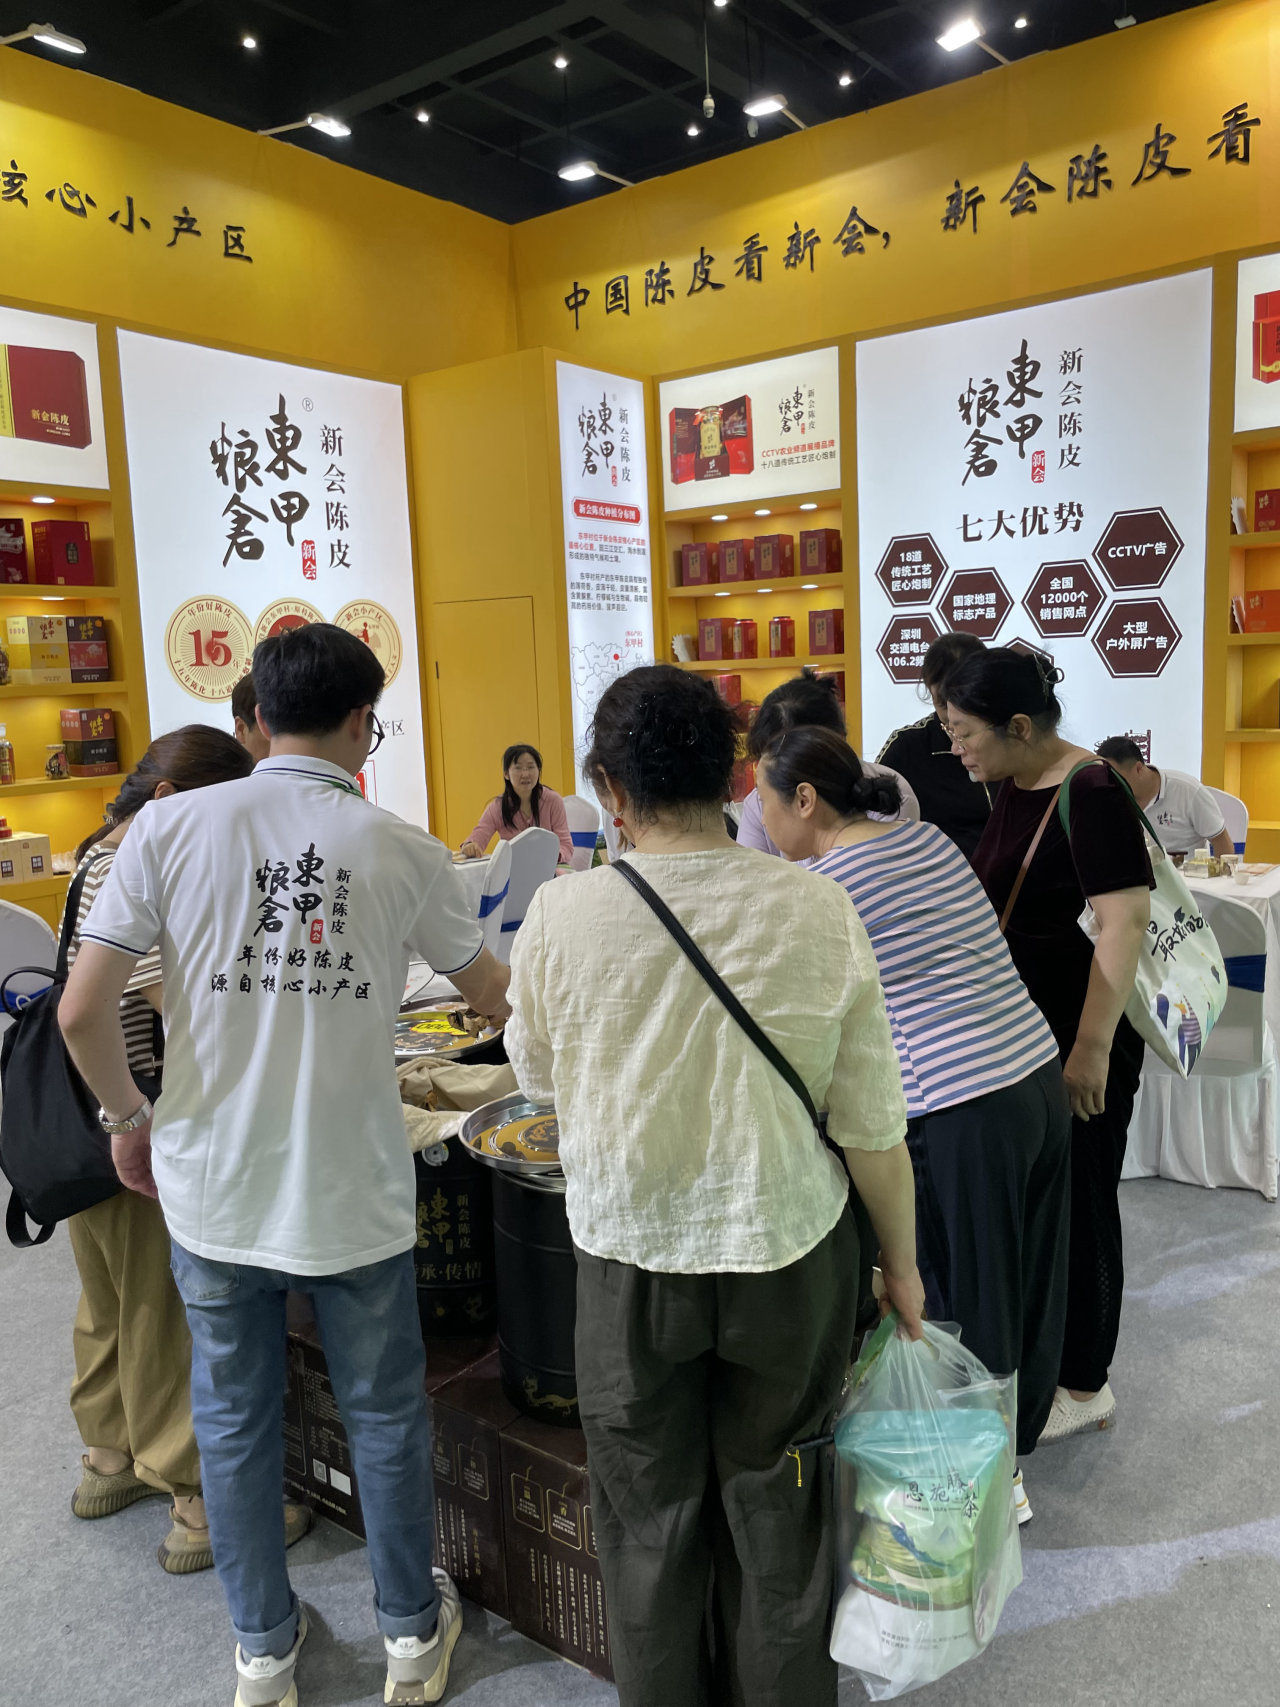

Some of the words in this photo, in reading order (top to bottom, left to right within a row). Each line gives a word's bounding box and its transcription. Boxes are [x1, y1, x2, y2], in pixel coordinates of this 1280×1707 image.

[564, 206, 890, 331] 中国陈皮看新会，
[941, 102, 1262, 234] 新会陈皮看
[1058, 347, 1084, 470] 新会陈皮
[619, 407, 632, 483] 新会陈皮
[1032, 453, 1045, 481] 新会
[320, 424, 352, 569] 新会陈皮
[956, 501, 1084, 543] 七大优势
[899, 550, 922, 563] 18道
[1107, 541, 1168, 559] CCTV广告
[302, 542, 317, 580] 新会
[891, 563, 932, 579] 传统工艺
[891, 577, 932, 592] 匠心炮制
[1049, 576, 1074, 590] 全国
[953, 592, 997, 607] 国家地理
[1040, 591, 1089, 604] 12000个
[953, 607, 997, 621] 标志产品
[1039, 606, 1087, 621] 销售网点
[900, 628, 922, 640] 深圳
[1122, 620, 1148, 635] 大型
[188, 629, 232, 667] 15
[889, 641, 931, 655] 交通电台
[1105, 636, 1168, 651] 户外屏广告
[331, 867, 352, 935] 新会陈皮
[311, 921, 323, 942] 新会
[236, 944, 355, 972] 年份好陈皮
[210, 972, 372, 1000] 源自核心小产区
[415, 1261, 482, 1281] 承·传情
